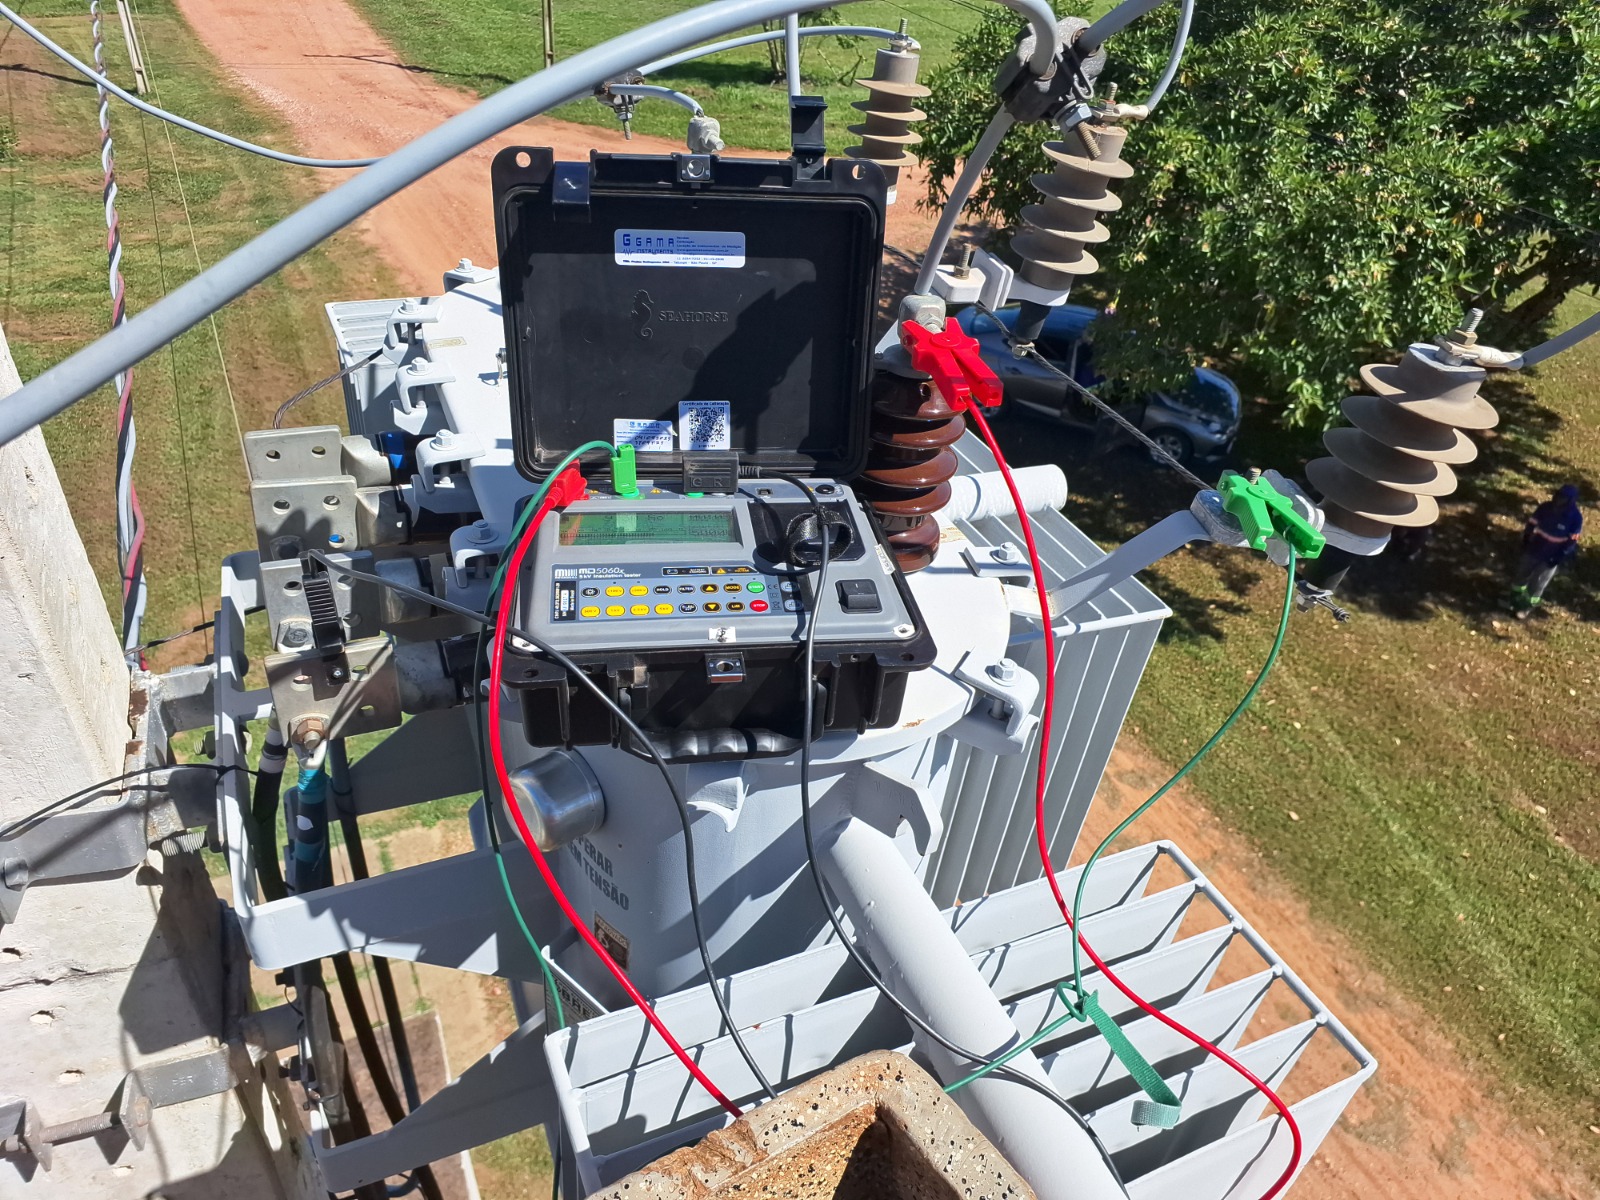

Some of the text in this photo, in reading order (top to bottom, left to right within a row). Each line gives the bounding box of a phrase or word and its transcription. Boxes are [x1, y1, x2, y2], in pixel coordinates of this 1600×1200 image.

[635, 237, 675, 247] GAMA
[659, 310, 728, 322] SEAHORSE
[576, 836, 613, 878] PERAR
[583, 857, 629, 911] TENSÃO
